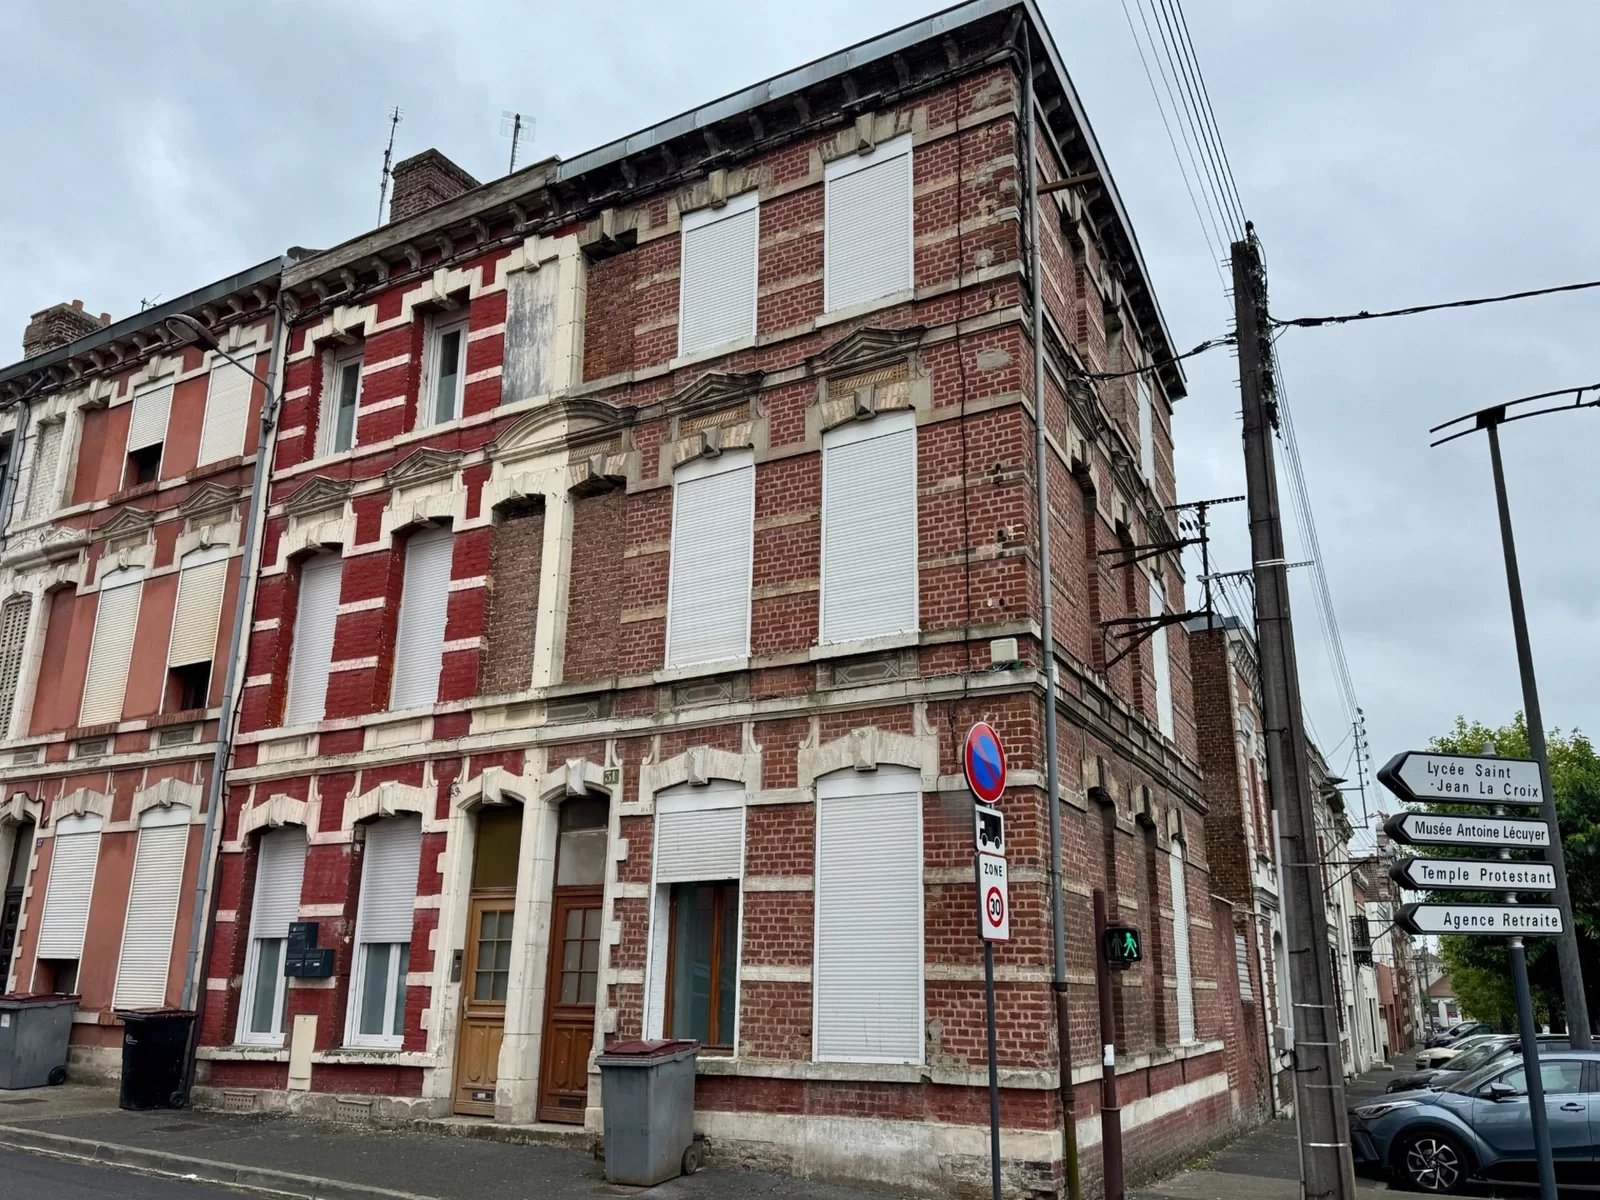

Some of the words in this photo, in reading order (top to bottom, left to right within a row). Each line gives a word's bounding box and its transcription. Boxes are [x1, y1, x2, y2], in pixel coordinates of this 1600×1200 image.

[1427, 760, 1464, 777] Lycée
[1475, 764, 1511, 779] Saint
[1479, 781, 1494, 795] La
[1503, 783, 1538, 797] Croix
[1415, 821, 1452, 836] Musée
[1456, 823, 1500, 838] Antoine
[1503, 825, 1546, 842] Lécuyer
[984, 862, 1003, 877] ZONE
[1421, 865, 1469, 883] Temple
[1480, 868, 1551, 884] Protestant
[990, 898, 1001, 916] 30
[1443, 912, 1495, 929] Agence
[1502, 913, 1558, 927] Retraite
